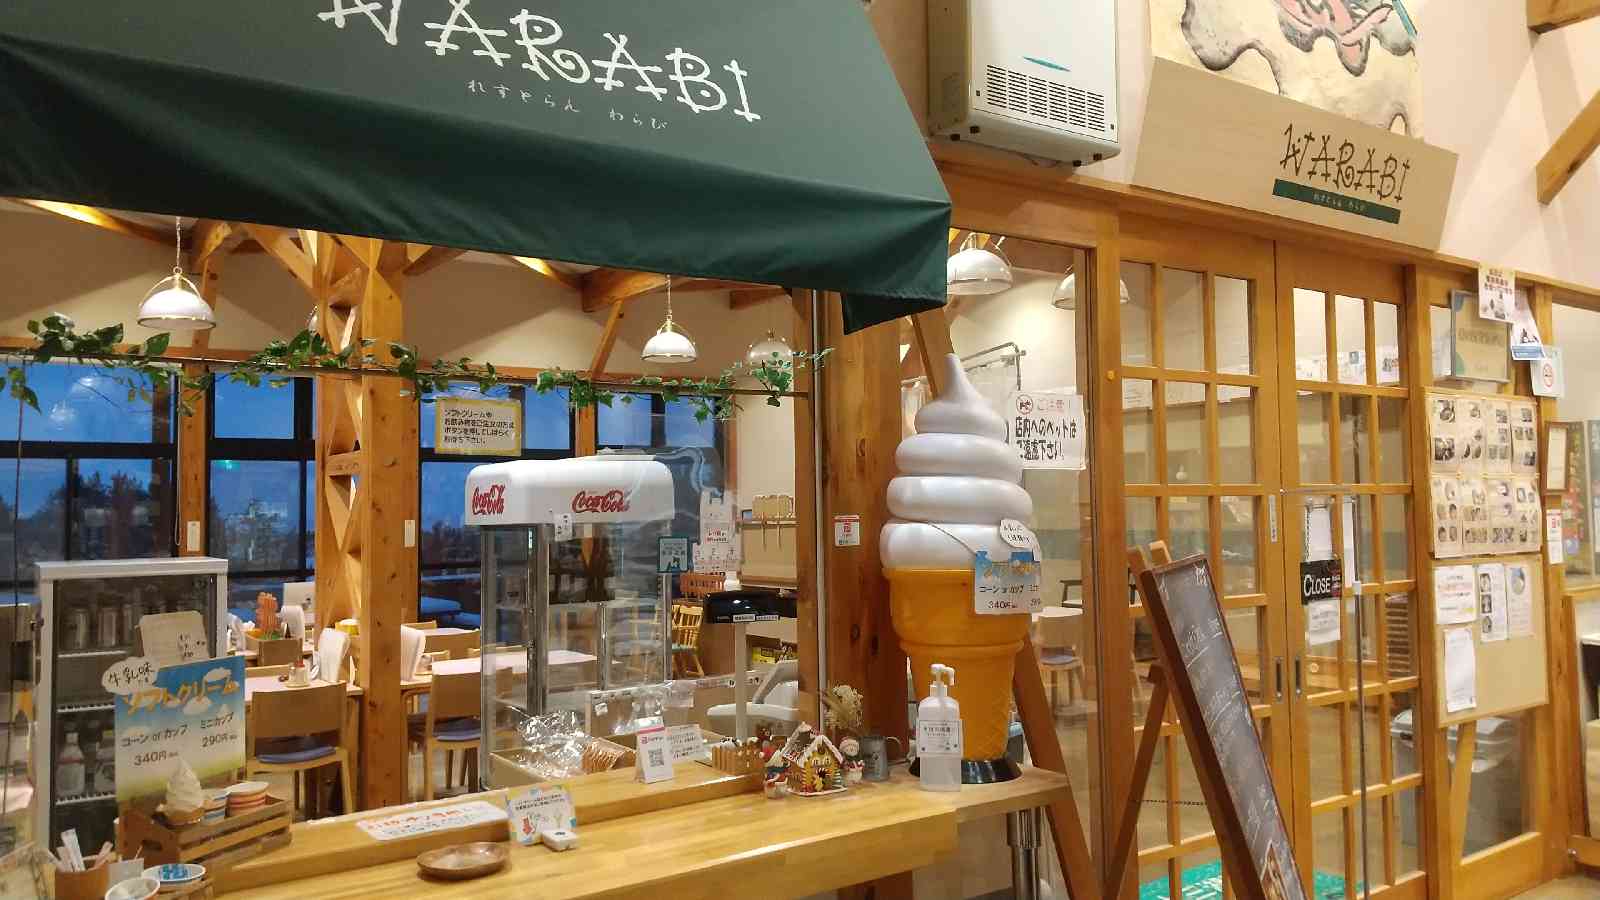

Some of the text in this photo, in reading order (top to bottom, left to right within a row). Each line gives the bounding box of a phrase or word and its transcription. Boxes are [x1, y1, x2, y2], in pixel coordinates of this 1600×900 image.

[1280, 123, 1411, 203] WARABI
[471, 485, 506, 515] Coca-Cola
[572, 488, 633, 514] Coca-Cola
